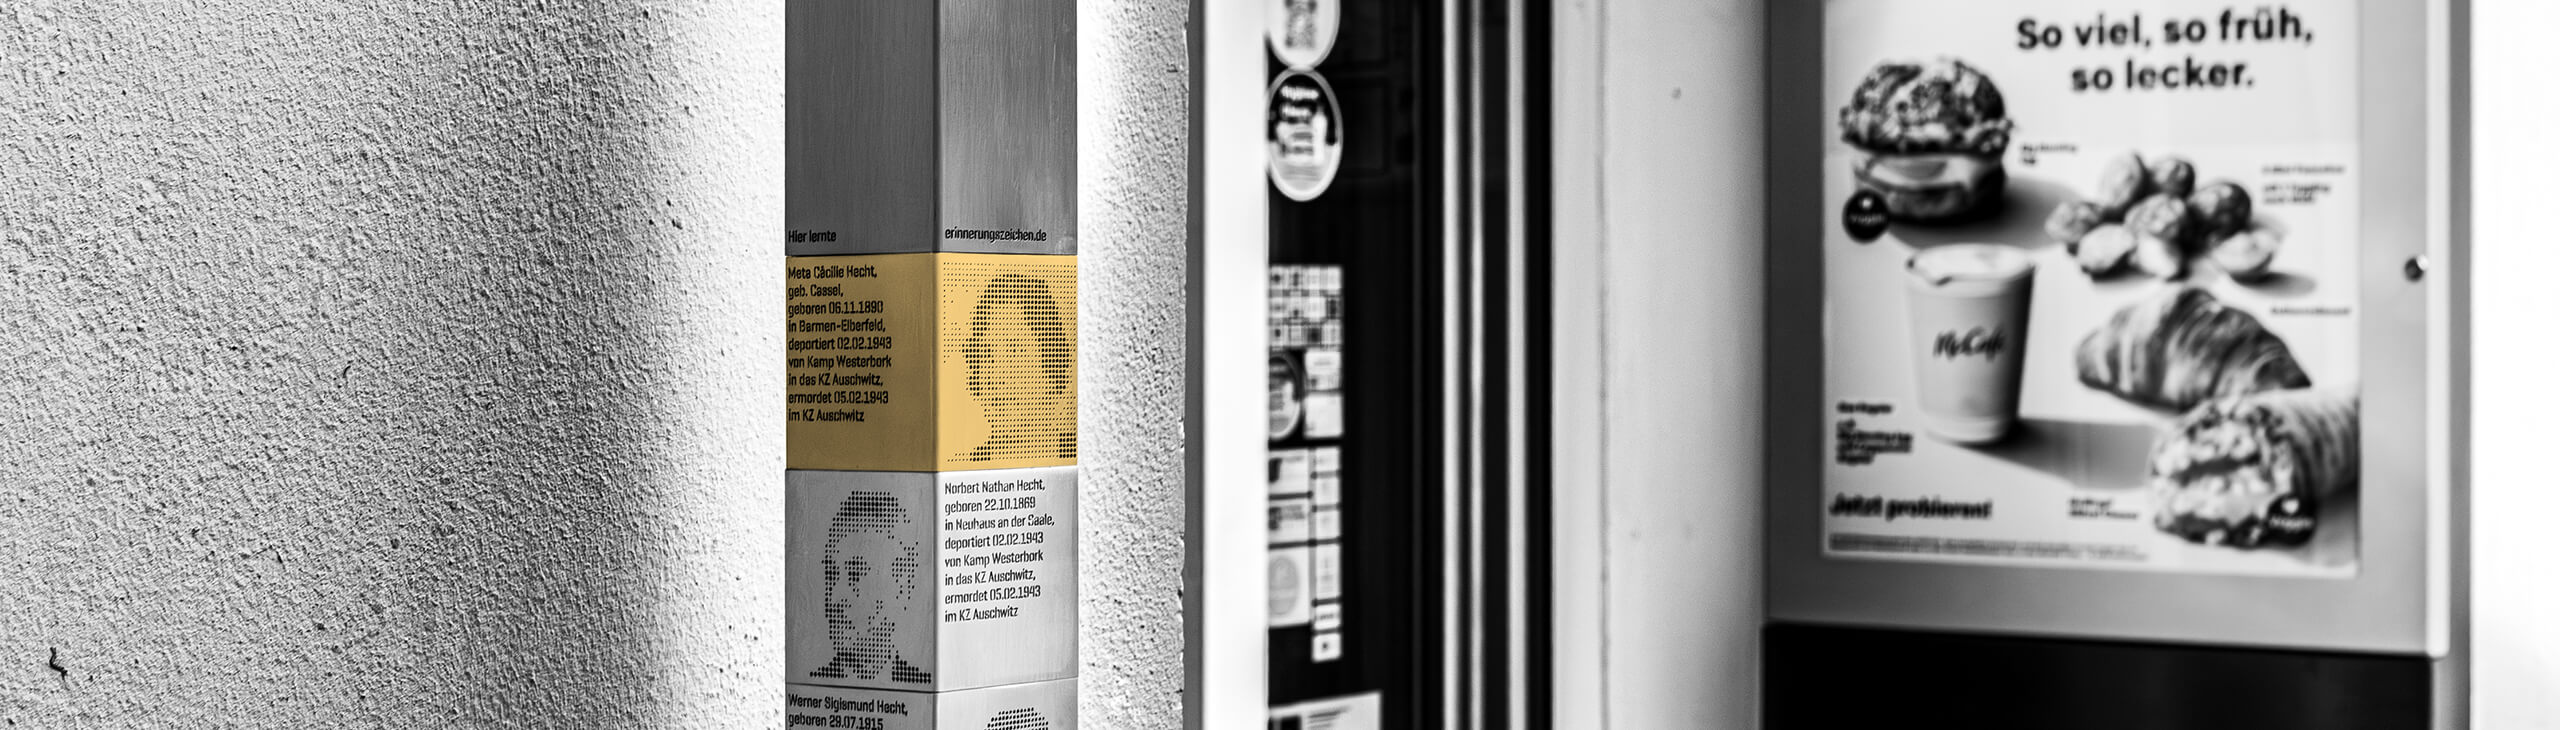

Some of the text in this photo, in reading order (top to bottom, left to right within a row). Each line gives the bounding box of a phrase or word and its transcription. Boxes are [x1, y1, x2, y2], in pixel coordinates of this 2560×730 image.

[2017, 8, 2313, 50] So viel, so früh,
[2071, 57, 2254, 91] so lecker.
[788, 229, 837, 243] Hier lernte
[944, 226, 1047, 243] erinnerungszeichen.de
[788, 266, 811, 280] Meta
[846, 264, 877, 278] Hecht,
[788, 283, 844, 300] geb. Cassel,
[788, 302, 827, 318] geboren
[788, 317, 886, 333] in Barmen-Elberfeld,
[788, 336, 892, 353] deportiert 02.02.1943
[788, 354, 893, 370] von Kamp Westerbork
[788, 372, 884, 387] in das KZ Auschwitz,
[788, 390, 889, 404] ermordet 05.02.1943
[788, 408, 865, 422] im KZ Auschwitz
[944, 478, 1046, 495] Norbert Nathan Hecht,
[944, 496, 1036, 516] geboren 22.10.1869
[1829, 492, 1883, 518] Jetzt
[944, 513, 1055, 531] in Neuhaus an der Saale,
[944, 531, 1044, 552] deportiert 02.02.1943
[944, 549, 1044, 568] von Kamp Westerbork
[944, 568, 1036, 586] in das KZ Auschwitz,
[944, 585, 1042, 604] ermordet 05.02.1943
[944, 604, 1019, 623] im KZ Auschwitz
[788, 693, 908, 717] Werner Sigismund Hecht,
[788, 712, 827, 727] geboren
